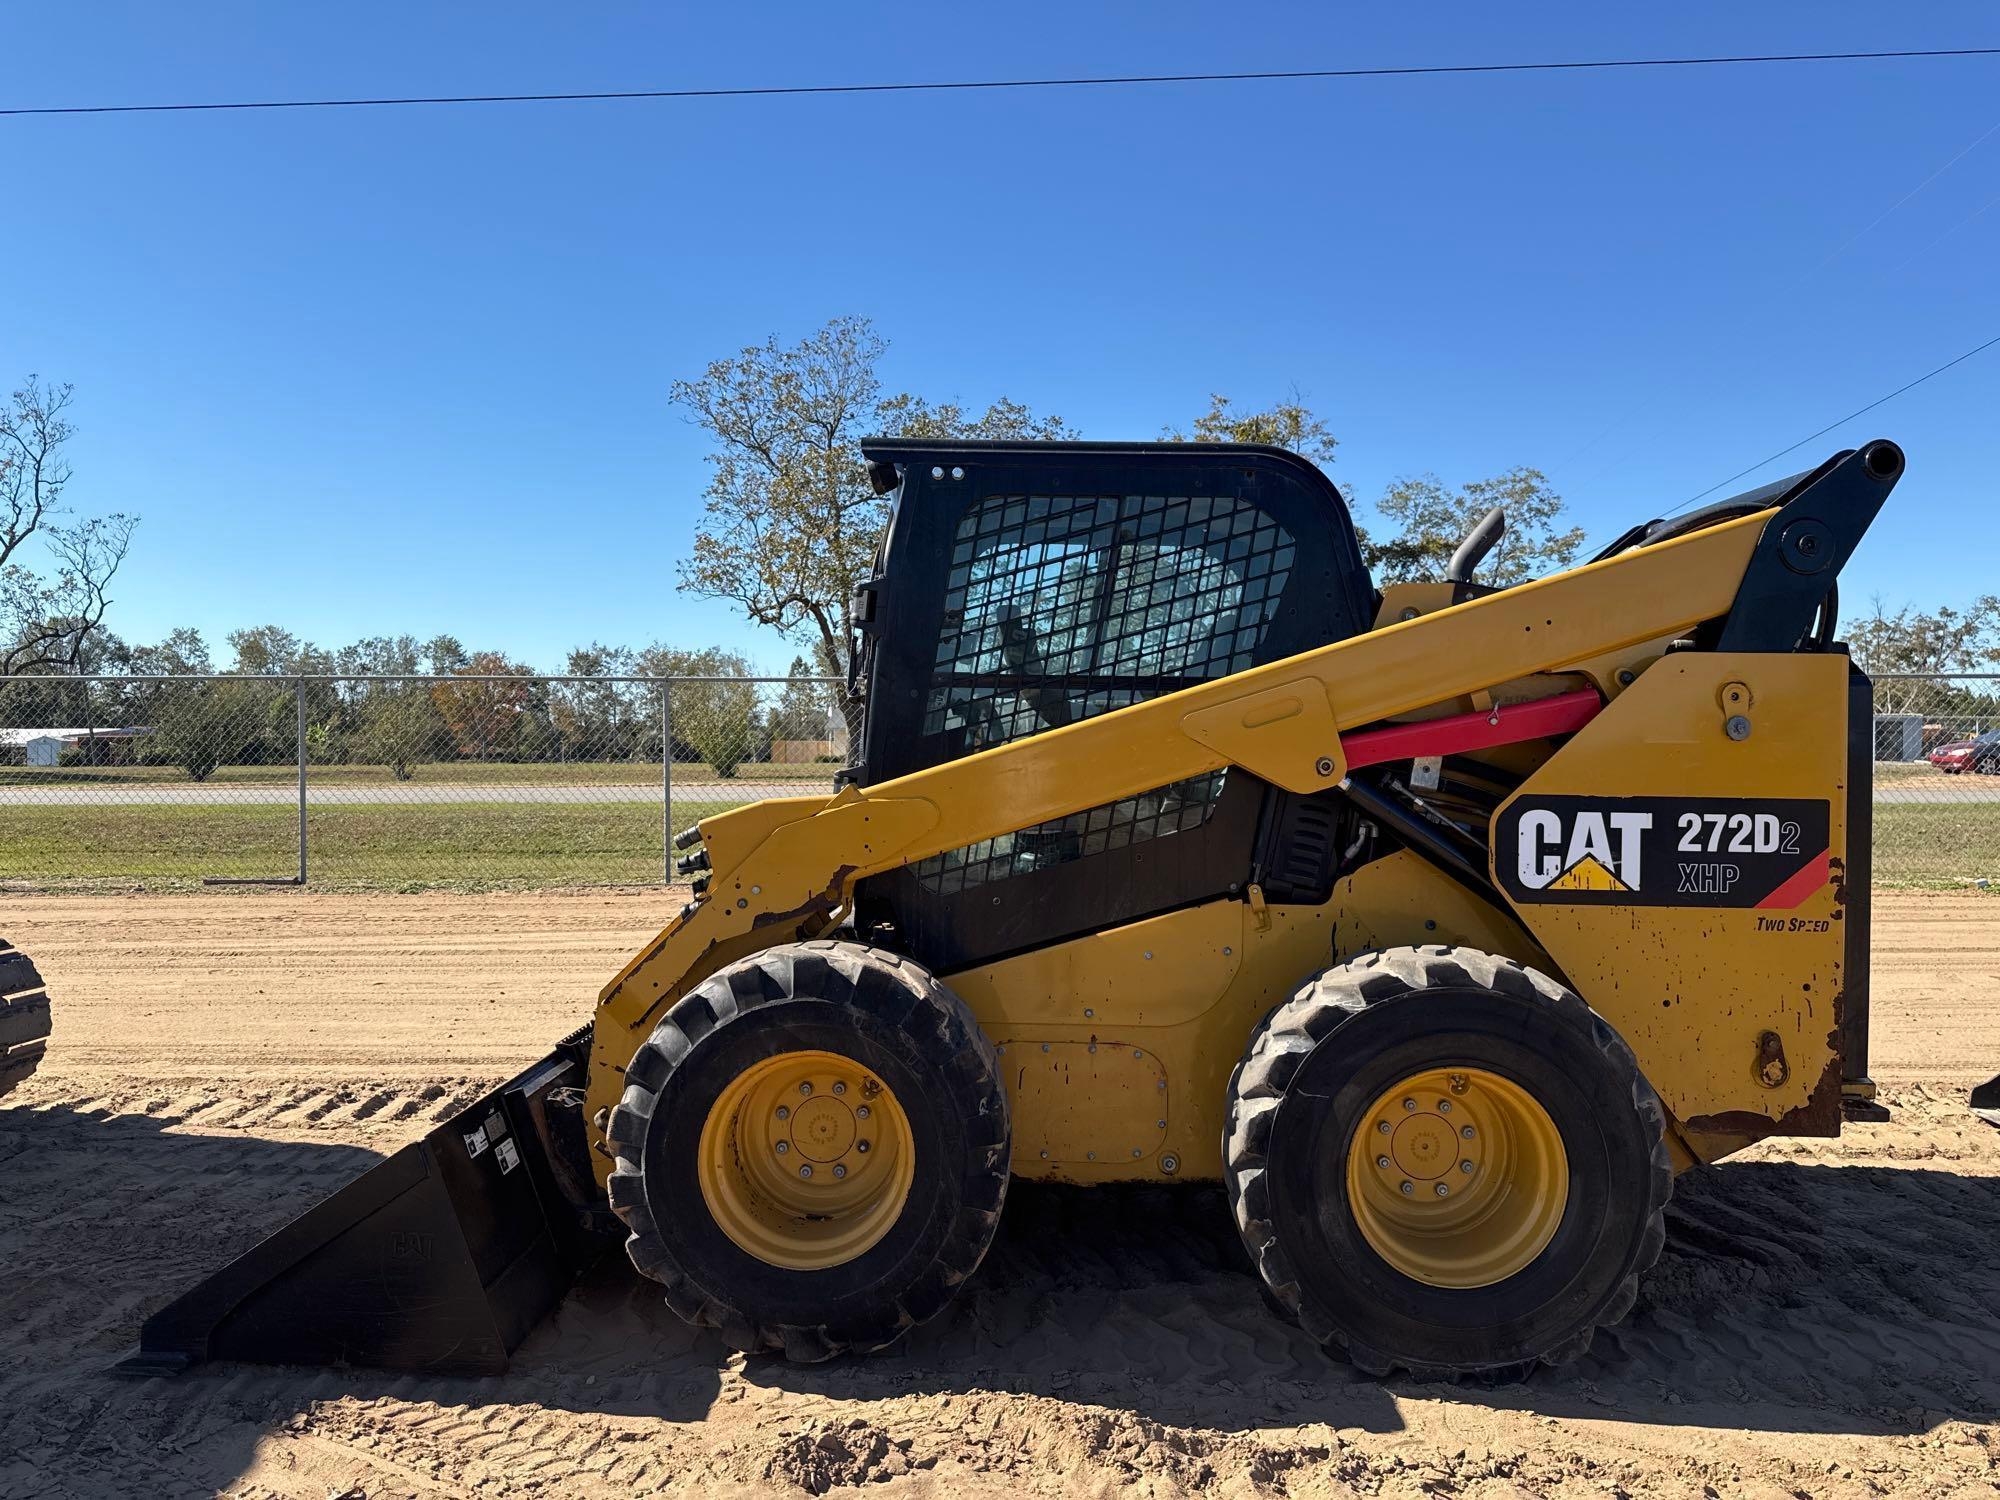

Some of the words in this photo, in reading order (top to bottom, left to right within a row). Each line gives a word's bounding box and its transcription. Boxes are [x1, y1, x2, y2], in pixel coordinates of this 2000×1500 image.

[1518, 809, 1653, 891] CAT
[1677, 812, 1800, 855] 272D2
[1677, 863, 1740, 893] XHP
[1757, 917, 1786, 932] TWO
[391, 1232, 434, 1259] CAT
